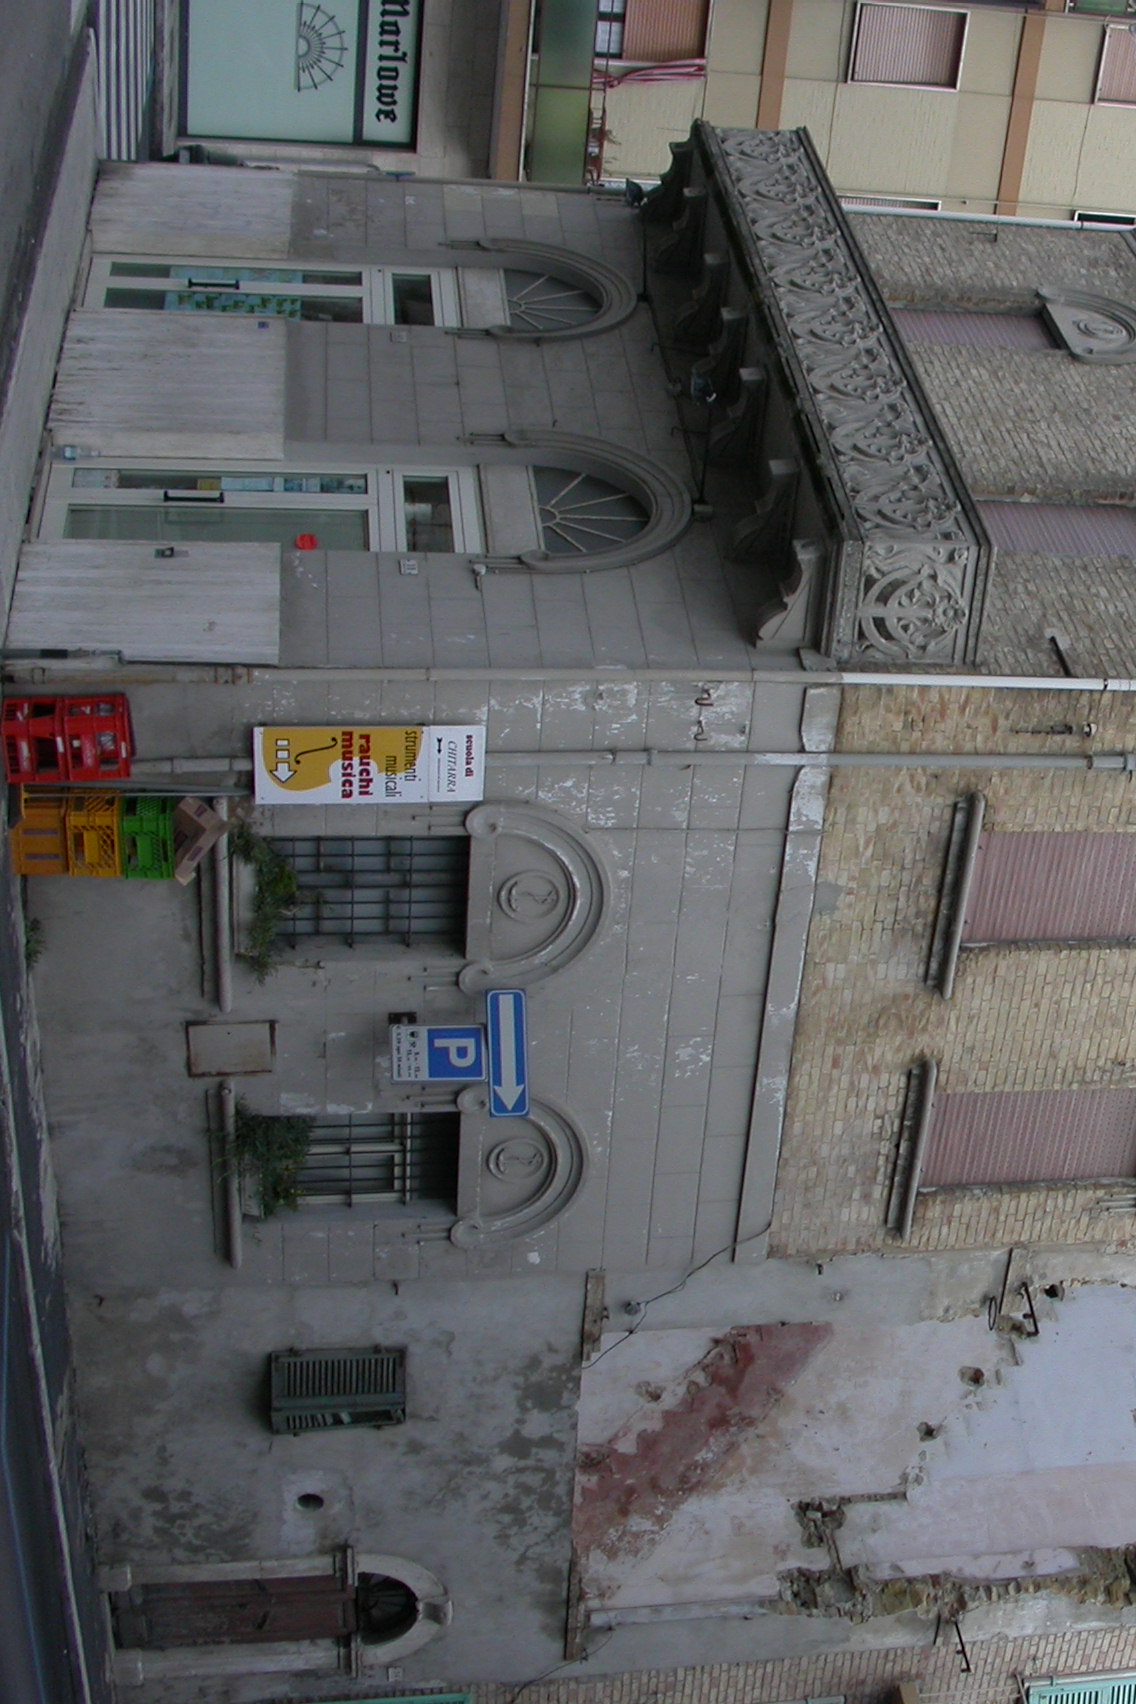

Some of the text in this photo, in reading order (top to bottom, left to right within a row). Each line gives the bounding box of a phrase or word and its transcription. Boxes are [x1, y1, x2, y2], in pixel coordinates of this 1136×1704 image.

[341, 731, 356, 799] musica
[358, 734, 373, 796] rauchi
[384, 755, 403, 798] musicali
[404, 730, 422, 782] strumenti
[447, 740, 458, 793] CHITARRA
[465, 734, 474, 778] scuola di
[433, 1038, 477, 1068] P
